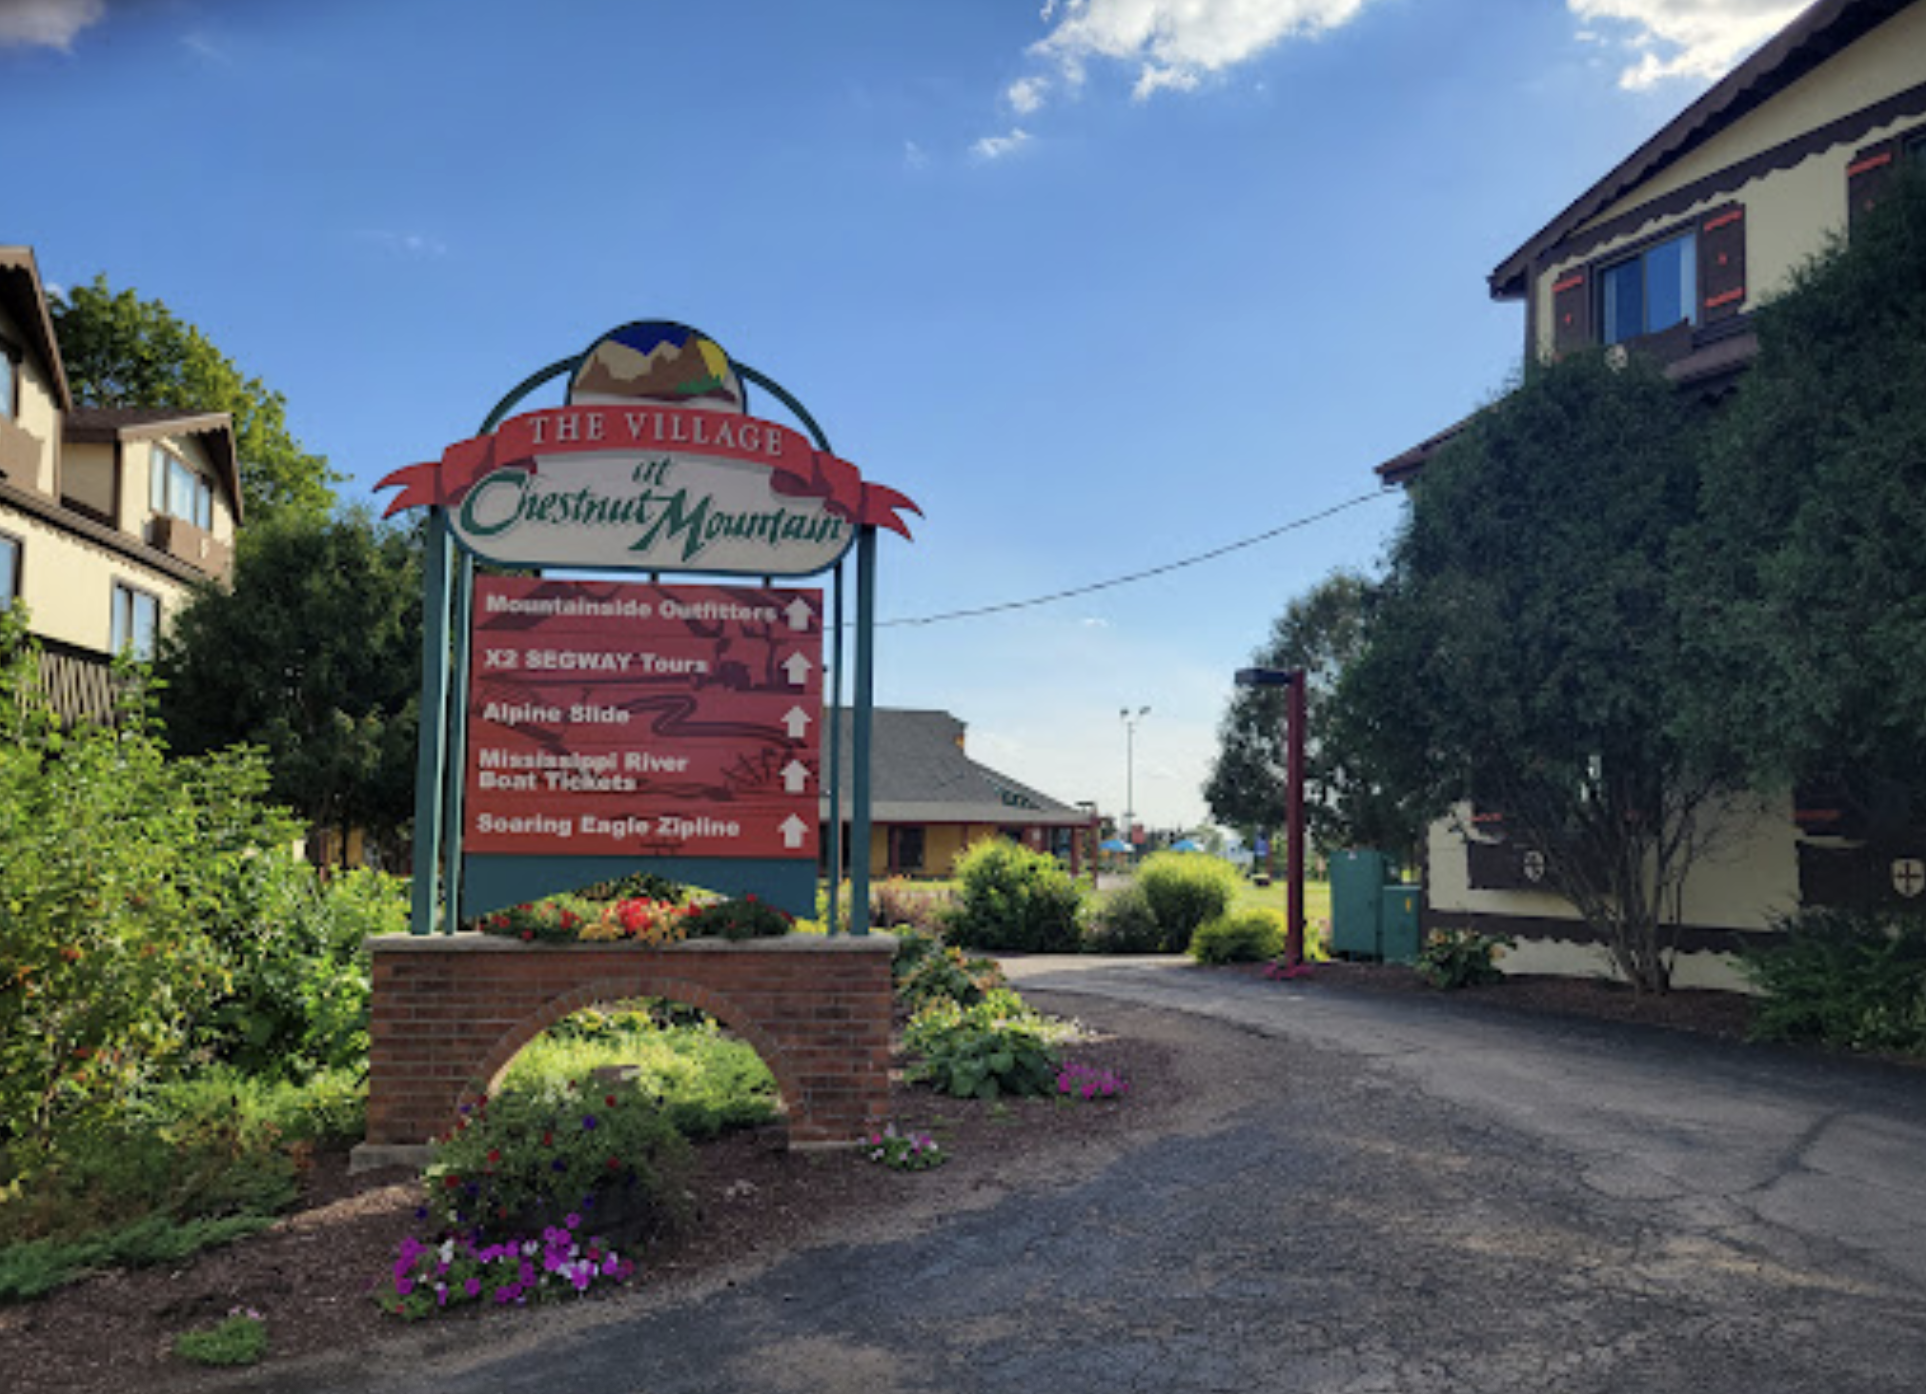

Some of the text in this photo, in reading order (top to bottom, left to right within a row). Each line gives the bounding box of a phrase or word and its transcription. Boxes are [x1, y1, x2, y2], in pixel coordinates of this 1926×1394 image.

[530, 413, 782, 456] THE VILLAGE
[632, 457, 673, 486] at
[460, 470, 846, 561] Chestnut Mountain
[486, 595, 777, 621] Mountainside Outfitters
[484, 649, 708, 673] X2 SEGWAY Tours
[483, 703, 630, 724] Alpine Slide
[478, 750, 689, 772] Mississippi River
[478, 772, 638, 791] Boat Tickets
[476, 813, 740, 838] Soaring Eagle Zipline
